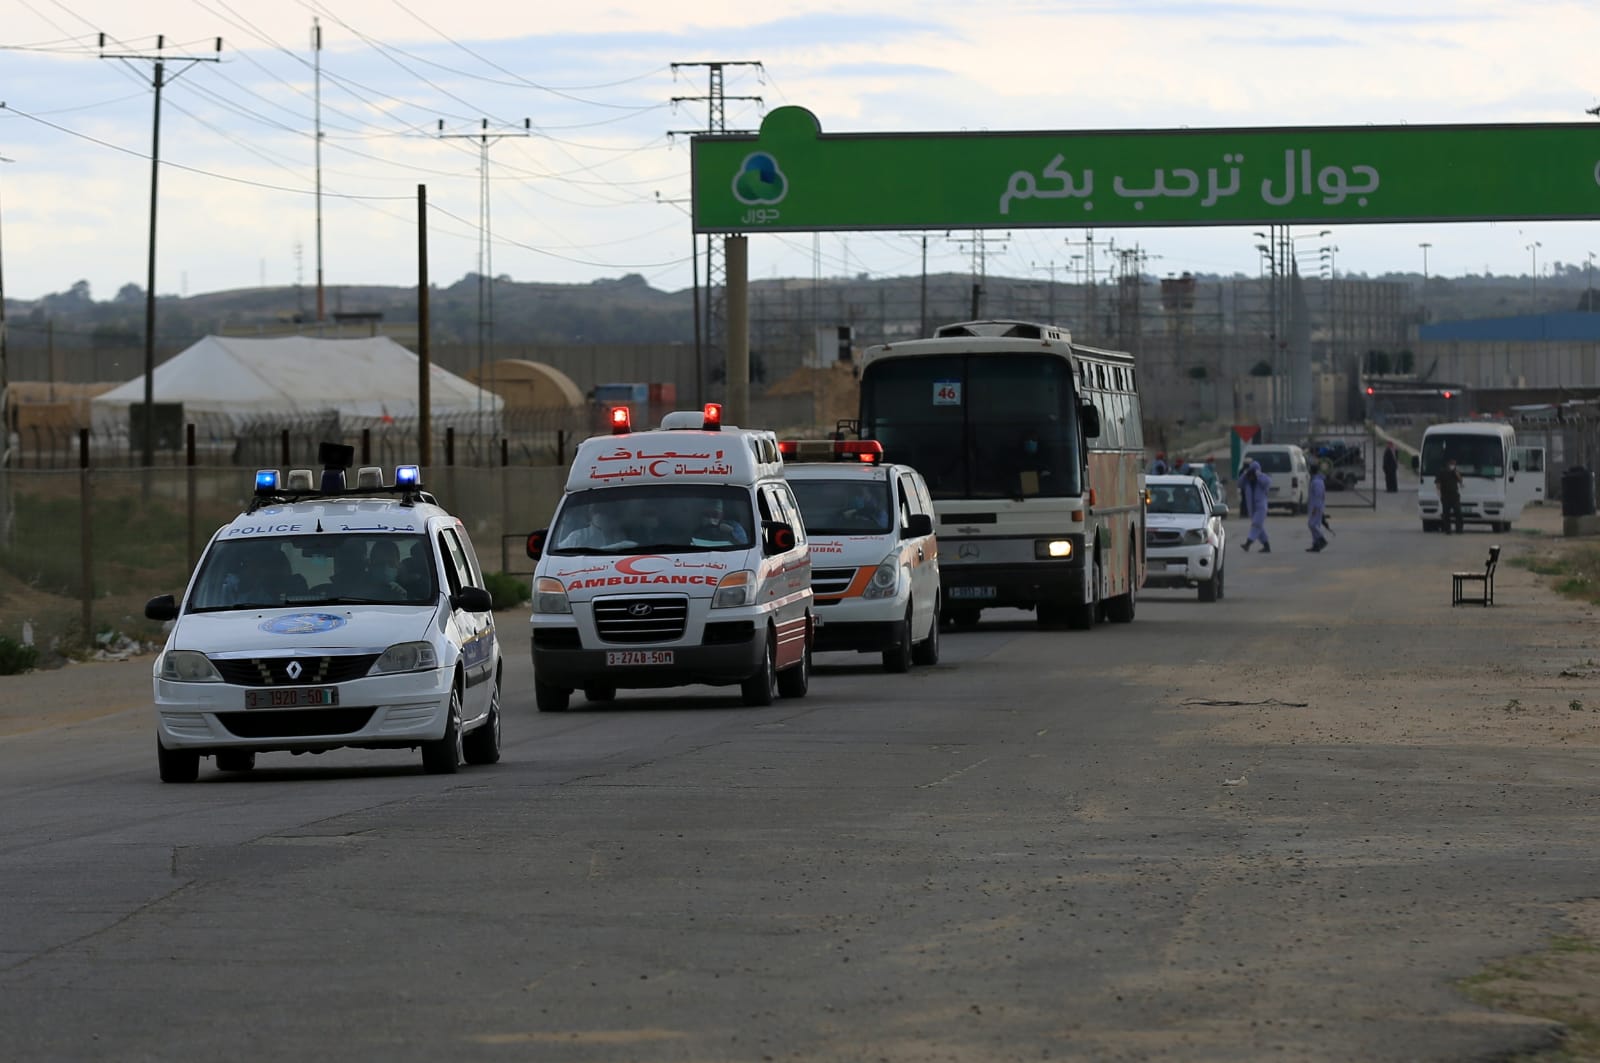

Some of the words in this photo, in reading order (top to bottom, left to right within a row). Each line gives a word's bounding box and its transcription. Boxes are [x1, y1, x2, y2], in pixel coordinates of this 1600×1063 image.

[999, 154, 1094, 214] بكم
[1113, 153, 1244, 211] ترحب
[1260, 149, 1380, 207] جوال
[741, 208, 780, 224] جوال
[938, 387, 956, 400] 46
[590, 465, 646, 482] الطبية
[674, 463, 733, 475] الخدمات
[228, 524, 301, 537] POLICE
[339, 523, 415, 532] شرطة
[567, 575, 718, 591] AMBULANCE
